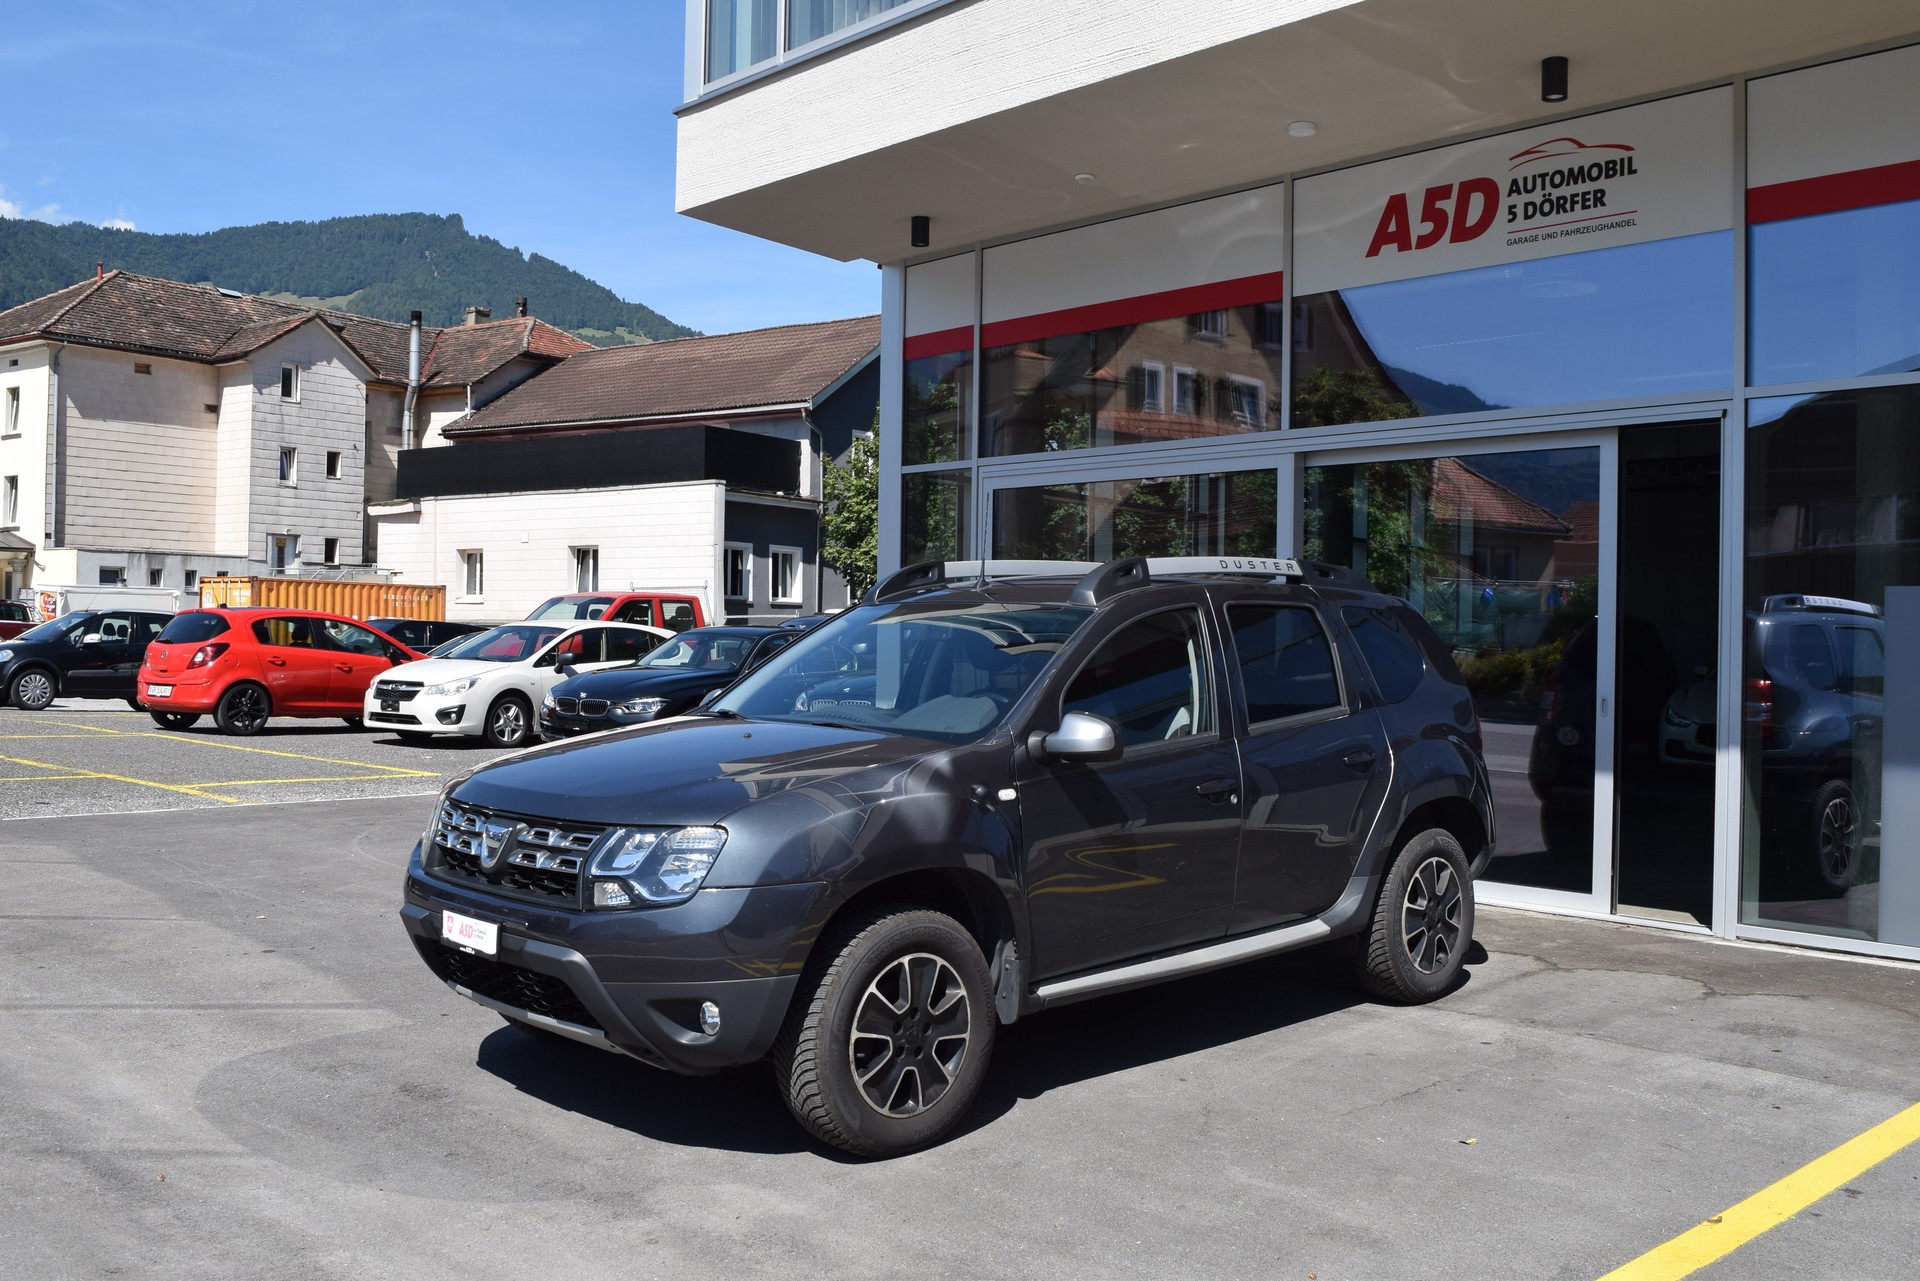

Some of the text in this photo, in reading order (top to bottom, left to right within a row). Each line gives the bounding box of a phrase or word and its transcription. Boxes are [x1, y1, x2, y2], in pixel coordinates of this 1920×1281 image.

[1506, 156, 1638, 198] AUTOMOBIL
[1365, 176, 1500, 258] A5D
[1507, 188, 1607, 223] 5 DÖRFER
[1506, 218, 1638, 246] GARAGE UND FAHRZEUGHANDEL
[1219, 560, 1296, 572] DUSTER
